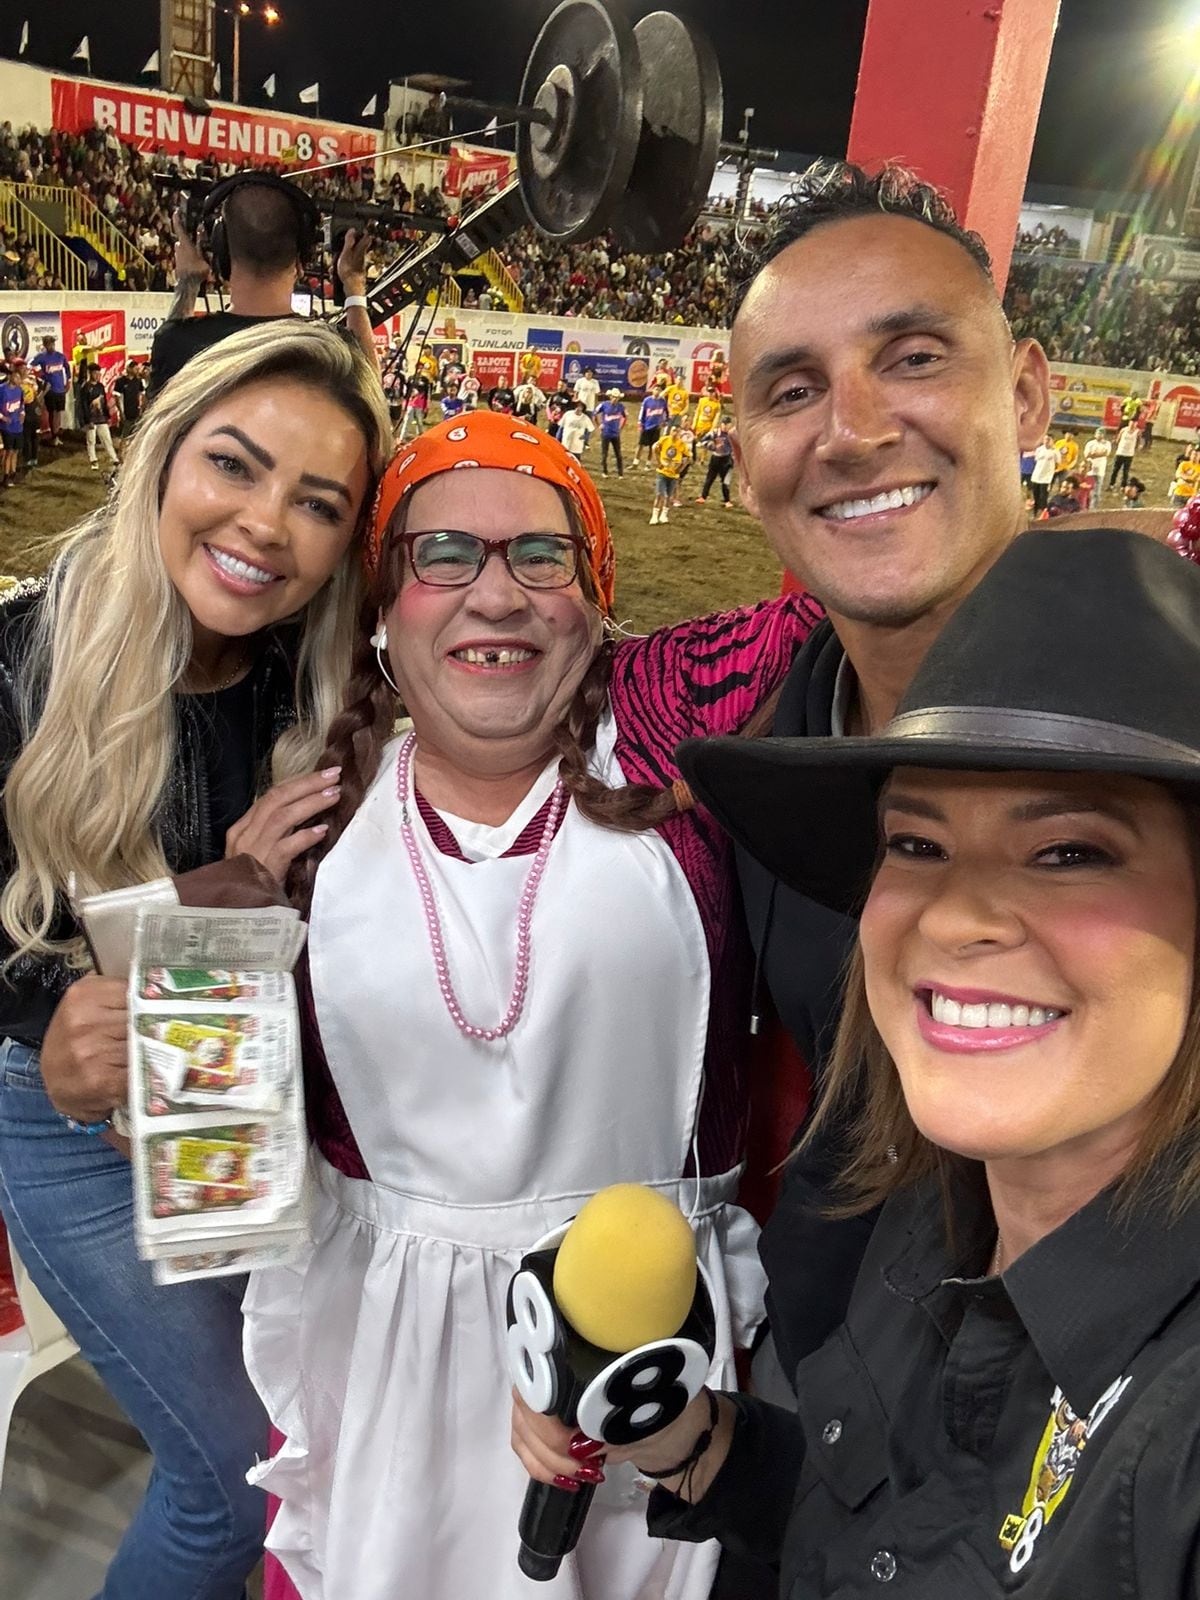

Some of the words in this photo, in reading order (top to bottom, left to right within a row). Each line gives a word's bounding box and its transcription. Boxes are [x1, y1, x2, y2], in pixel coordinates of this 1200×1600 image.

[130, 317, 158, 330] 4000
[471, 338, 525, 350] TUNLAND
[507, 1271, 555, 1414] 8
[600, 1344, 689, 1445] 8
[1010, 1506, 1044, 1573] 8
